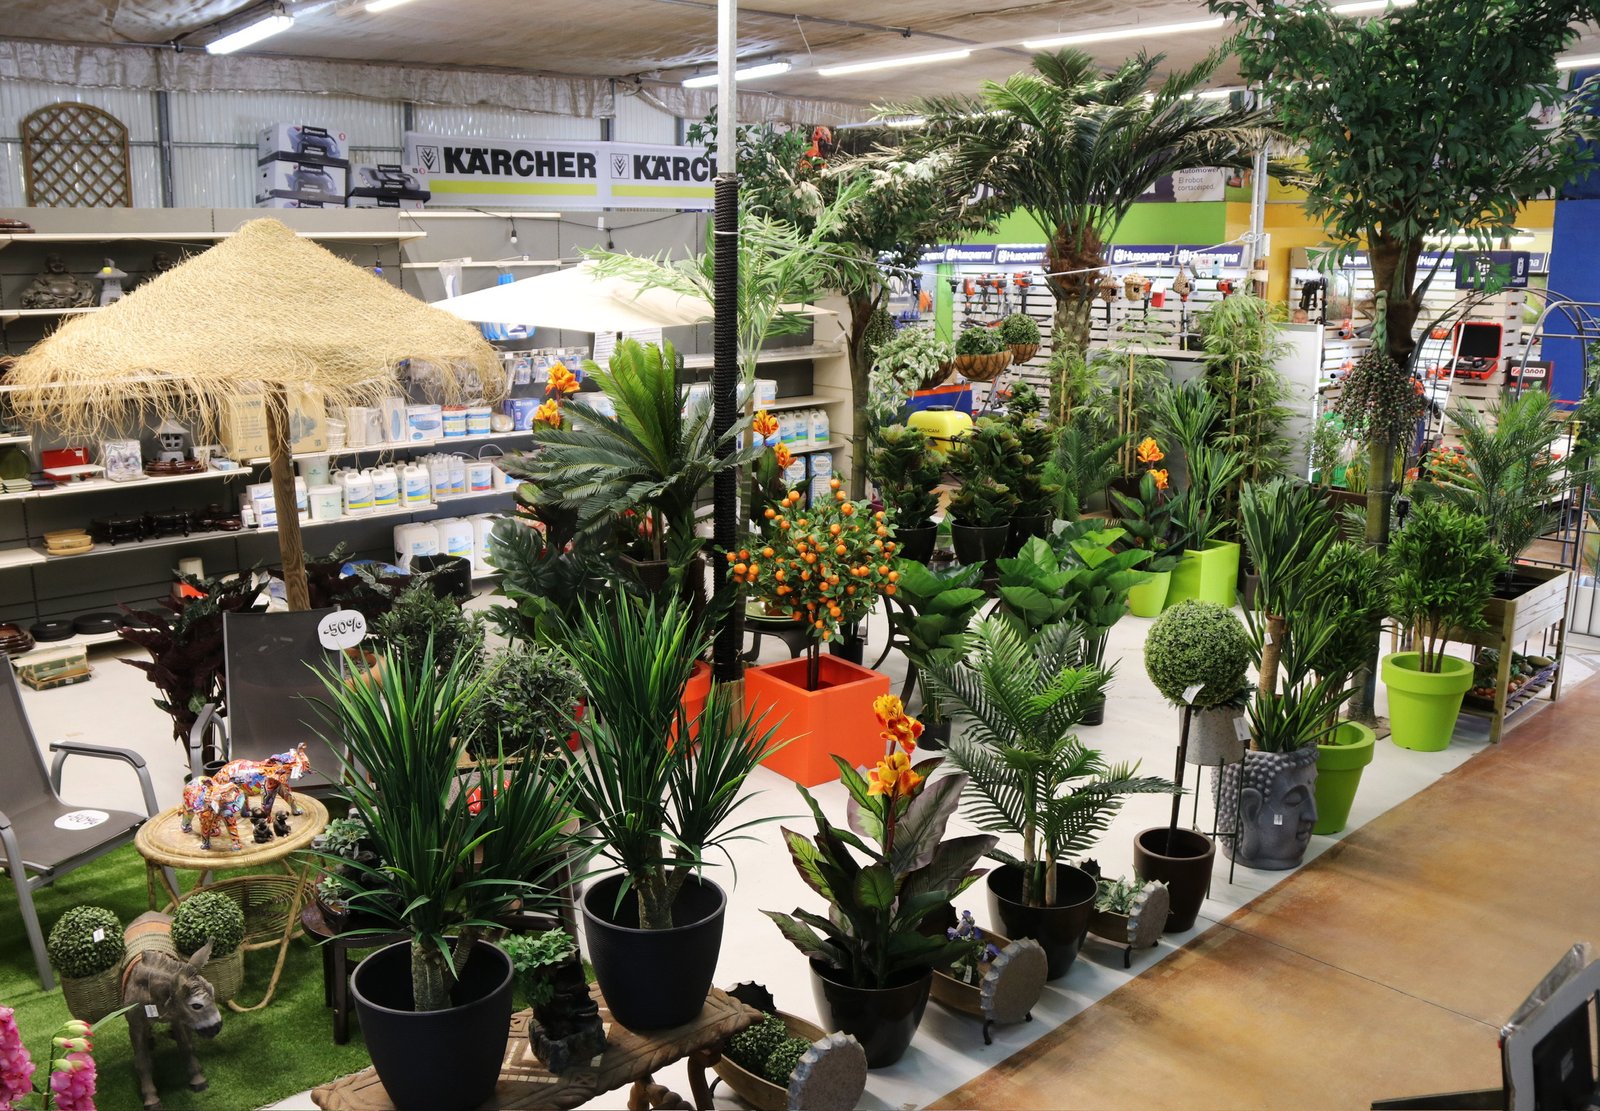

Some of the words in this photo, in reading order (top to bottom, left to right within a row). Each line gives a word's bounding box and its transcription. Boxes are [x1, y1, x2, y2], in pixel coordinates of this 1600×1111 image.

[442, 146, 598, 178] KÄRCHER
[633, 154, 717, 182] KÄRC
[1123, 251, 1172, 264] Husqvarna
[323, 617, 363, 637] -50%
